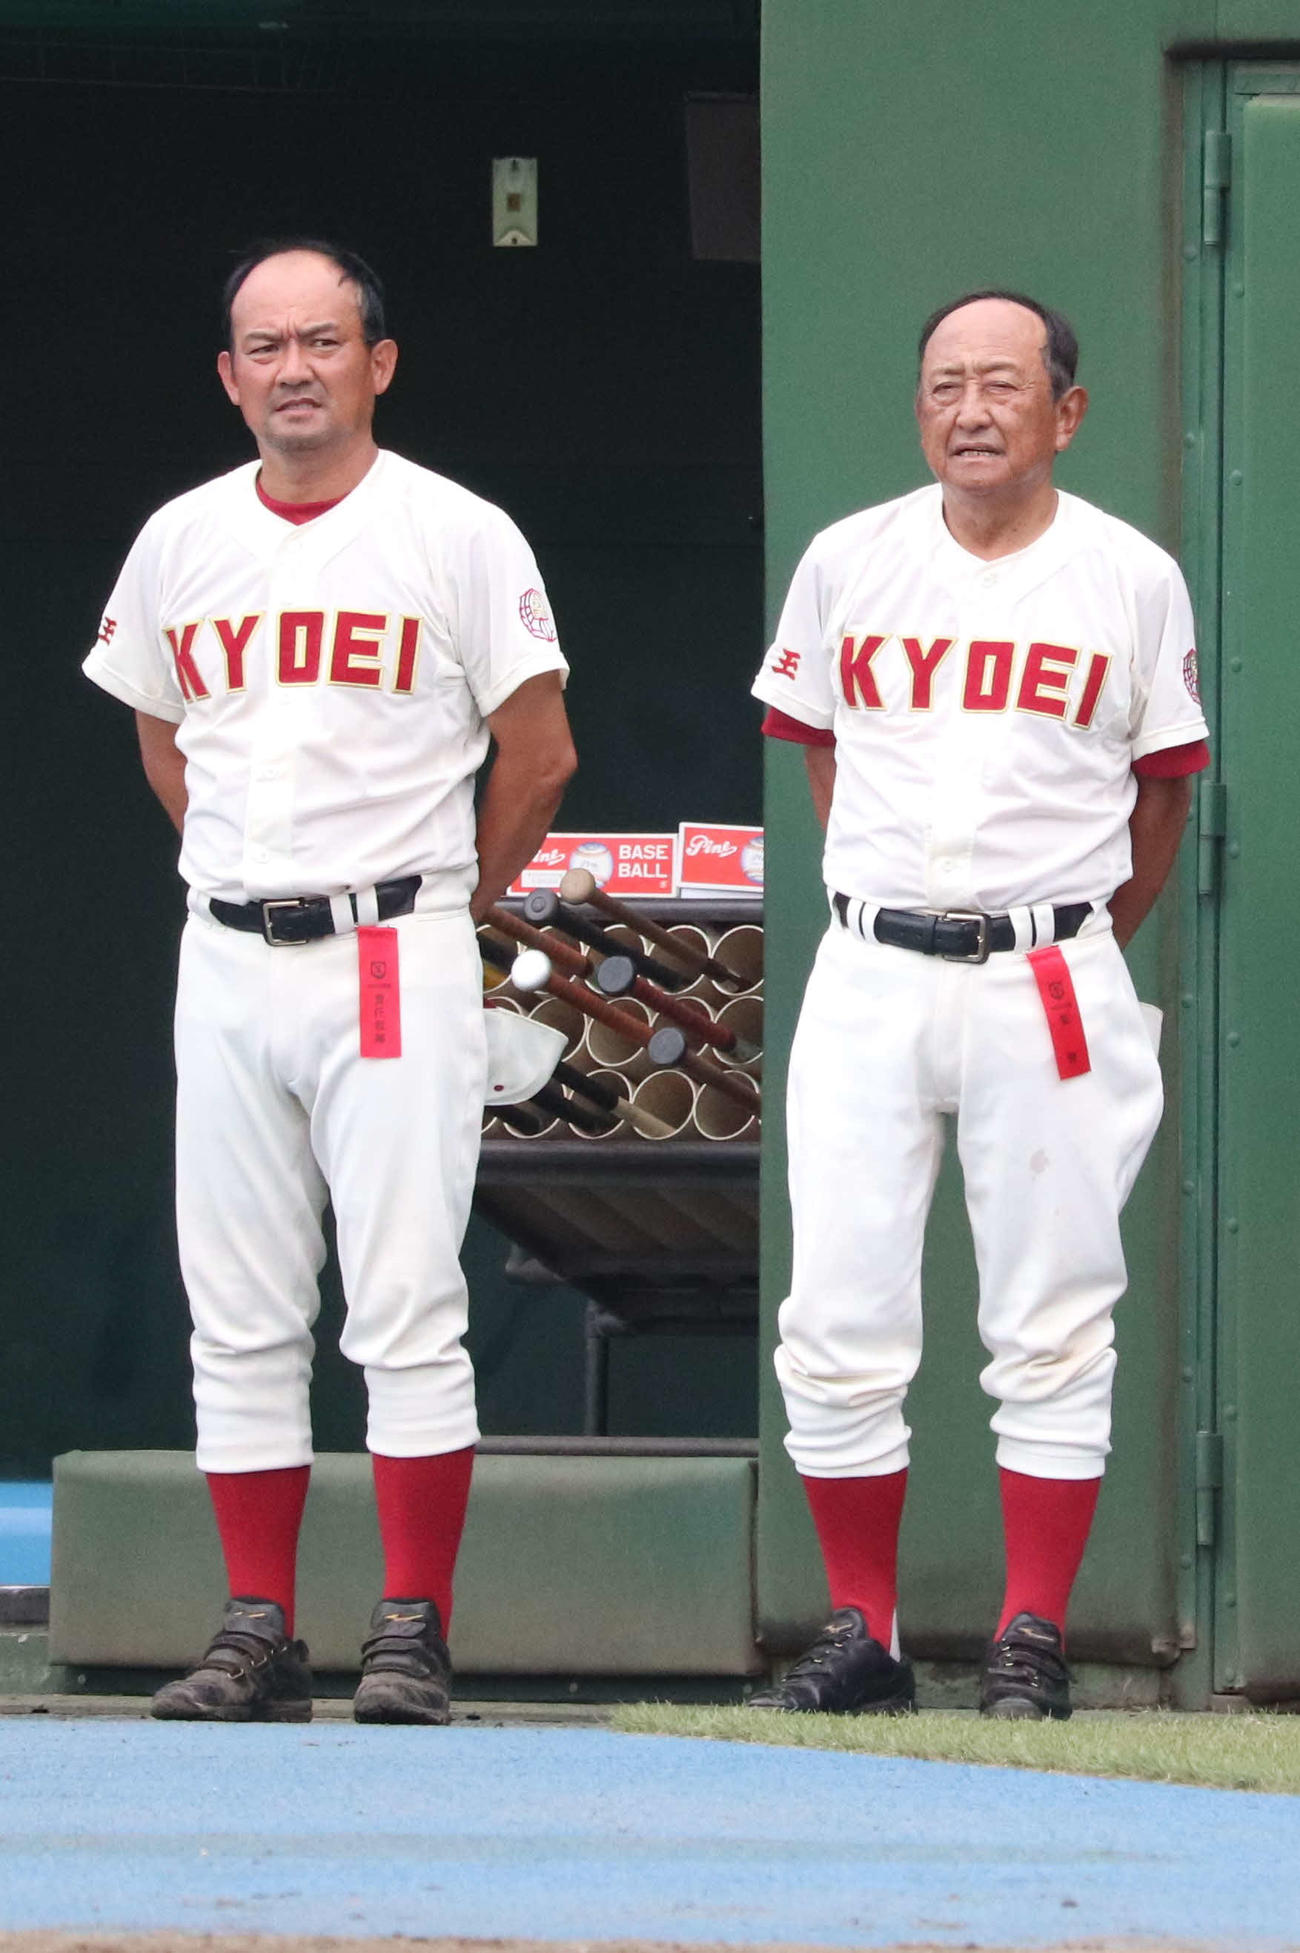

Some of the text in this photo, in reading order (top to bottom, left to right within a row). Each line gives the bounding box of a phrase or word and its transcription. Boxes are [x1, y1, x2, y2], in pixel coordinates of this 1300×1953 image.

[162, 608, 425, 703] KYOEI
[838, 632, 1113, 731] KYOEI
[531, 848, 566, 867] ine
[619, 844, 669, 860] BASE
[618, 862, 668, 879] BALL
